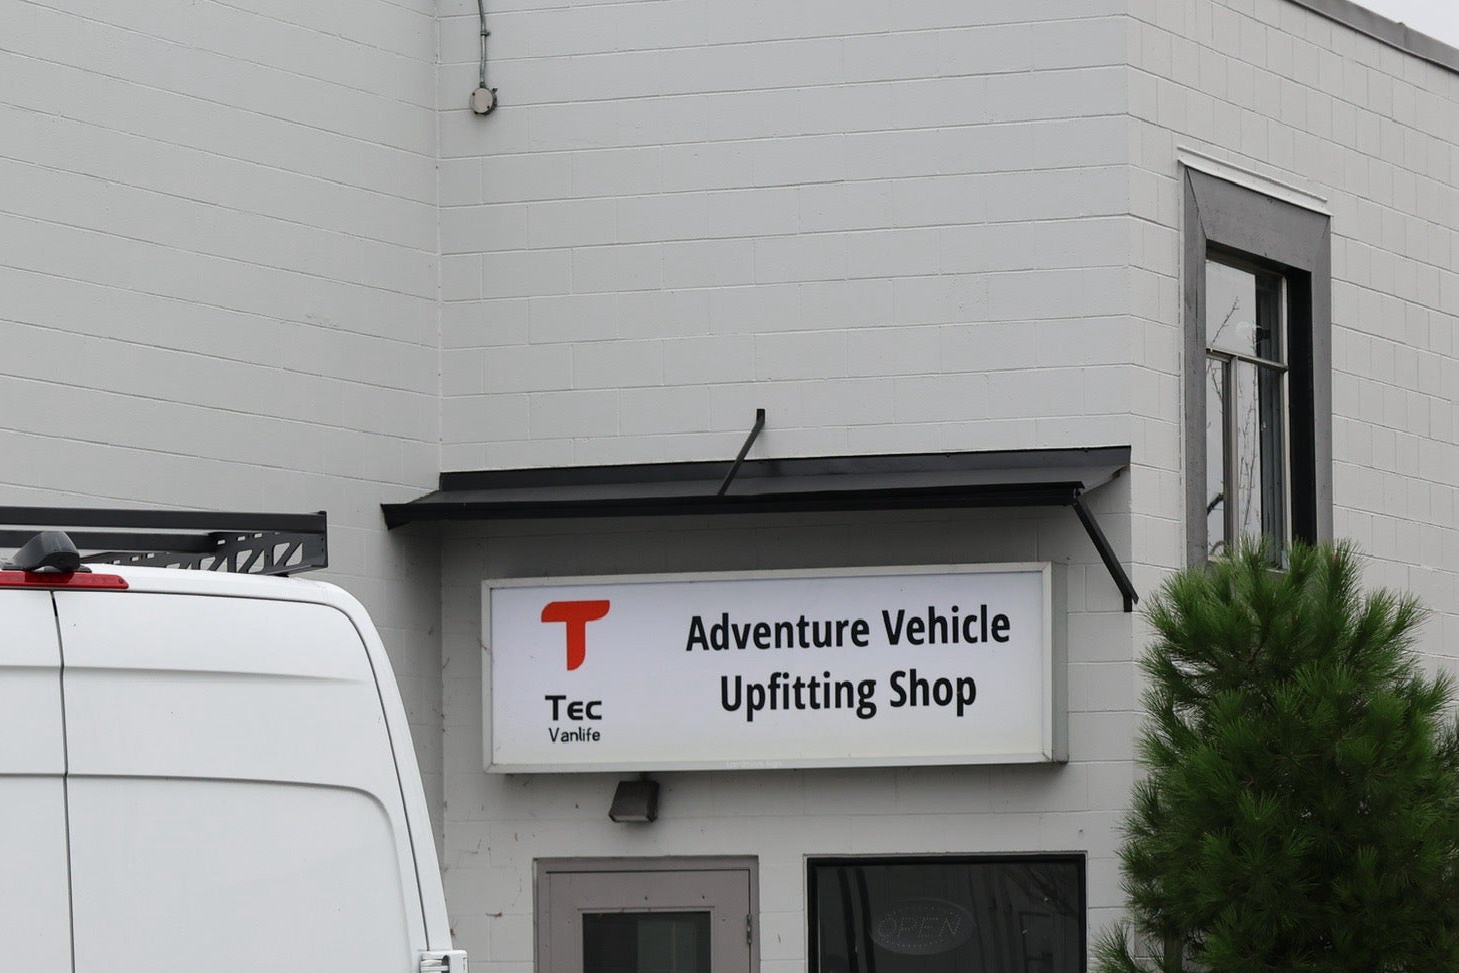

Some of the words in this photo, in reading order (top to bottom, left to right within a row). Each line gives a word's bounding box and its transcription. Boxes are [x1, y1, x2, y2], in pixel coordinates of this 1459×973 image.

[686, 612, 870, 652] Adventure
[882, 604, 1011, 646] Vehicle
[720, 670, 877, 722] Upfitting
[889, 669, 977, 717] Shop
[548, 726, 601, 743] Vanlife
